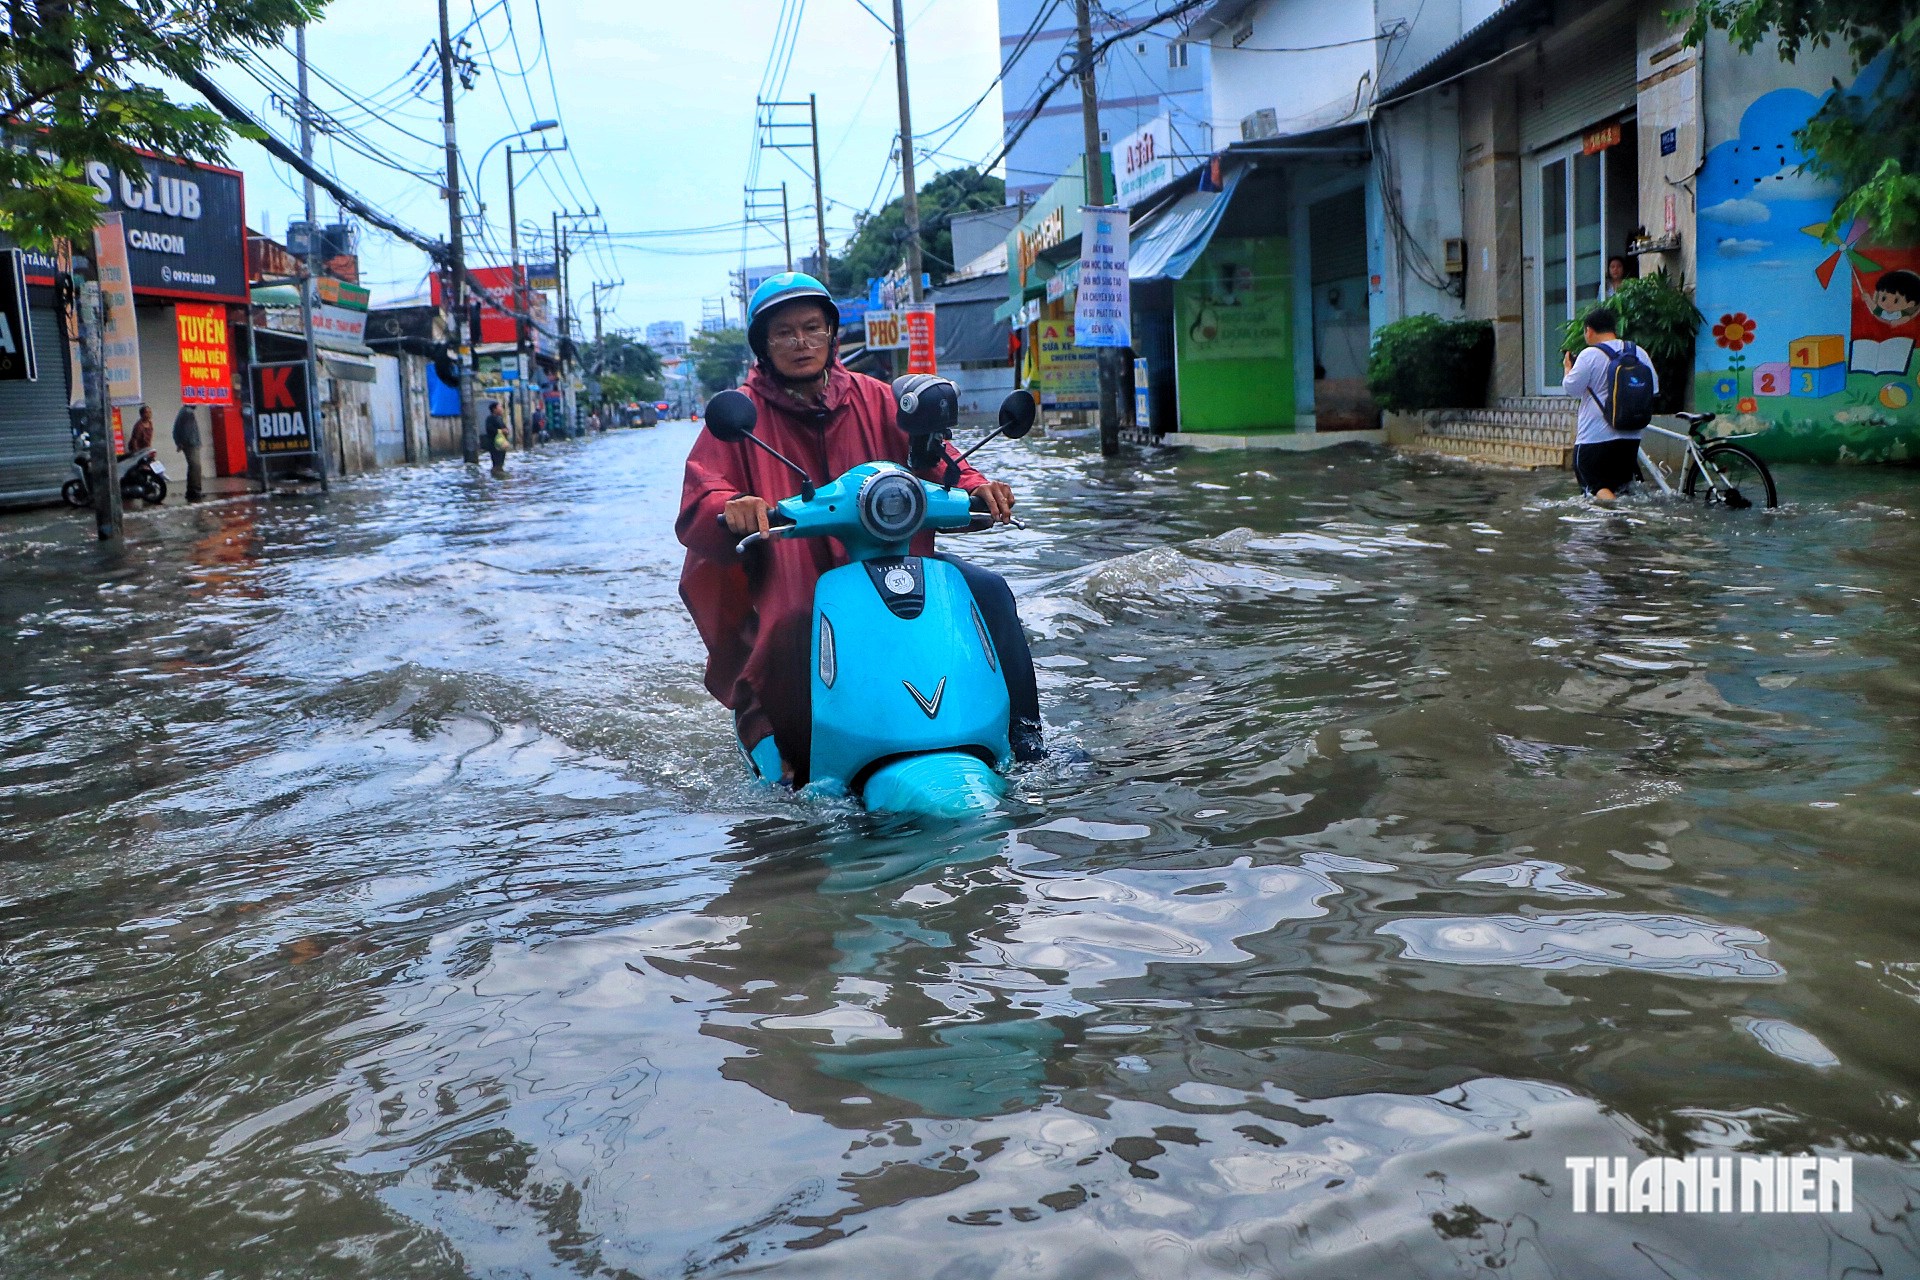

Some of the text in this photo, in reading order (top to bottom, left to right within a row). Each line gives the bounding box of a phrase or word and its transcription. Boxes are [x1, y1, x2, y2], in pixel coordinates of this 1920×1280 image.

[119, 168, 201, 220] CLUB
[129, 228, 185, 255] CAROM
[179, 307, 226, 344] TUYỂN
[868, 313, 899, 346] PHỞ
[1042, 339, 1072, 351] SỬA XE
[182, 346, 227, 365] NHÂN VIÊN
[1796, 347, 1809, 366] 1
[190, 366, 220, 382] PHỤC VỤ
[1761, 373, 1776, 393] 2
[1800, 373, 1813, 392] 3
[262, 367, 296, 409] K
[258, 411, 307, 437] BIDA
[877, 564, 917, 573] VINFAST
